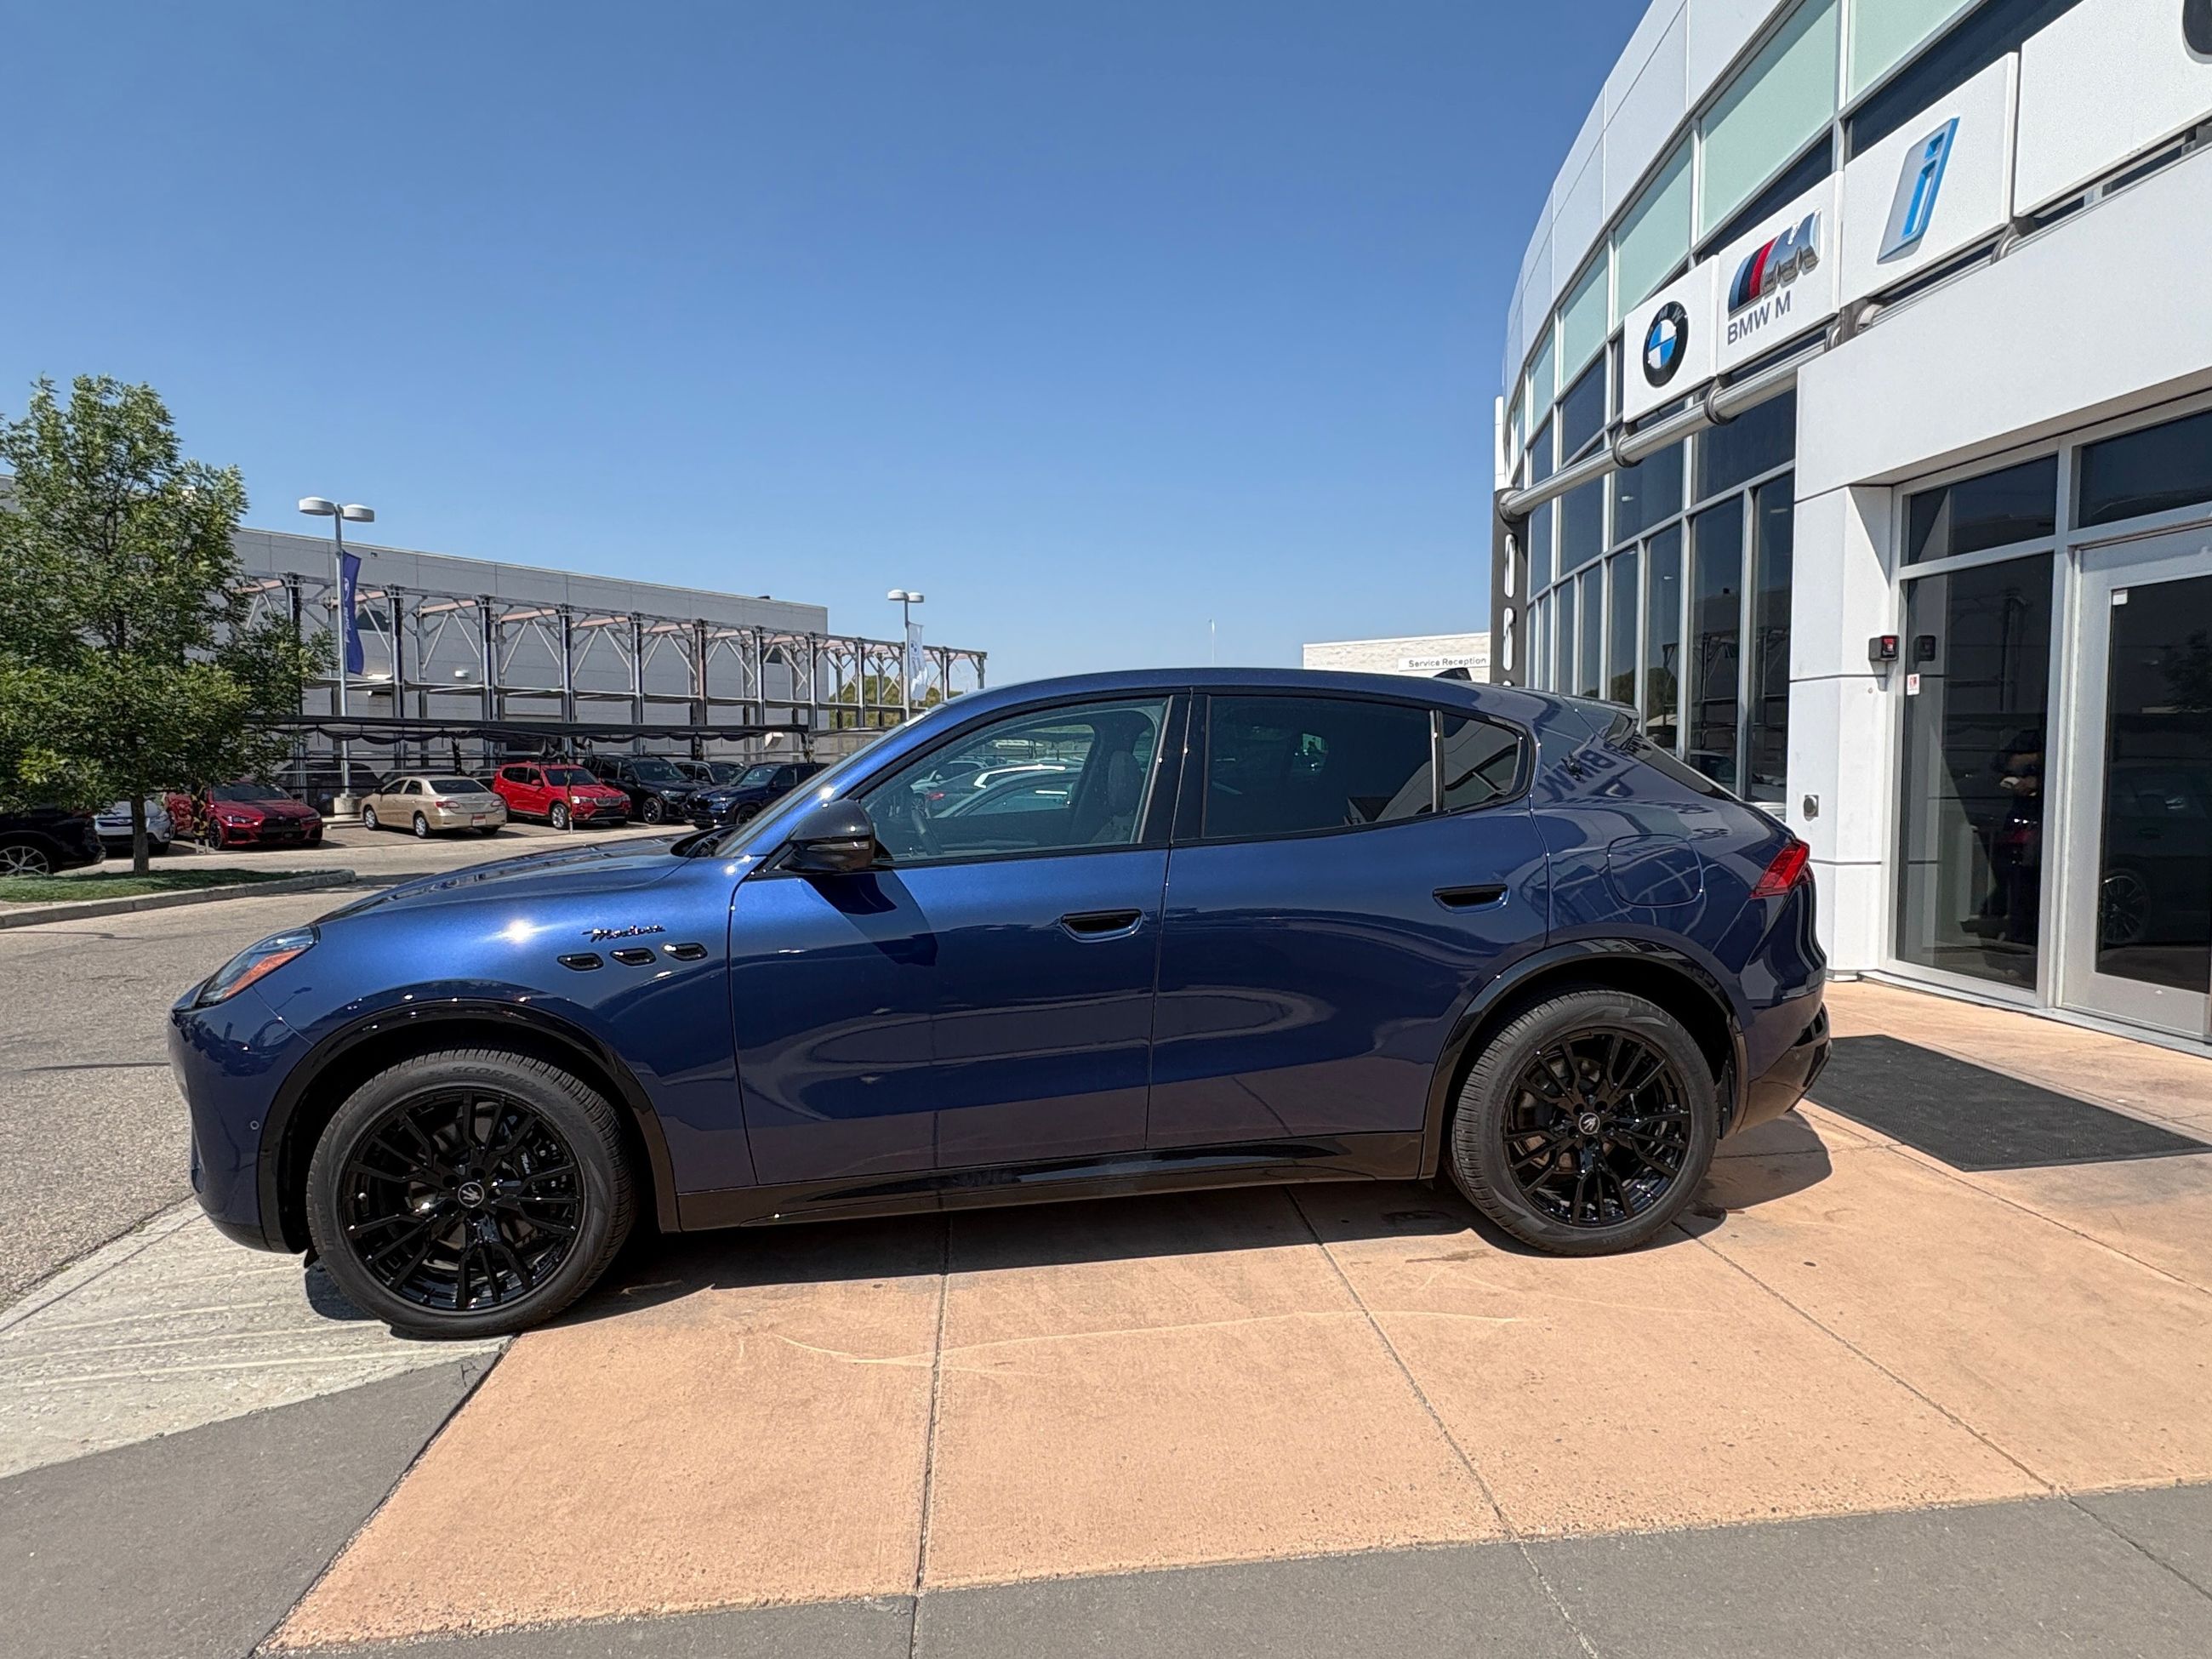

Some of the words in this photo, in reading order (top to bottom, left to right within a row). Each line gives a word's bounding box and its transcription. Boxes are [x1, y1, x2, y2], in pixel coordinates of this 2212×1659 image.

[1727, 302, 1771, 346] BMW
[1775, 290, 1792, 319] M
[1408, 659, 1440, 668] Service
[1442, 657, 1487, 666] Reception
